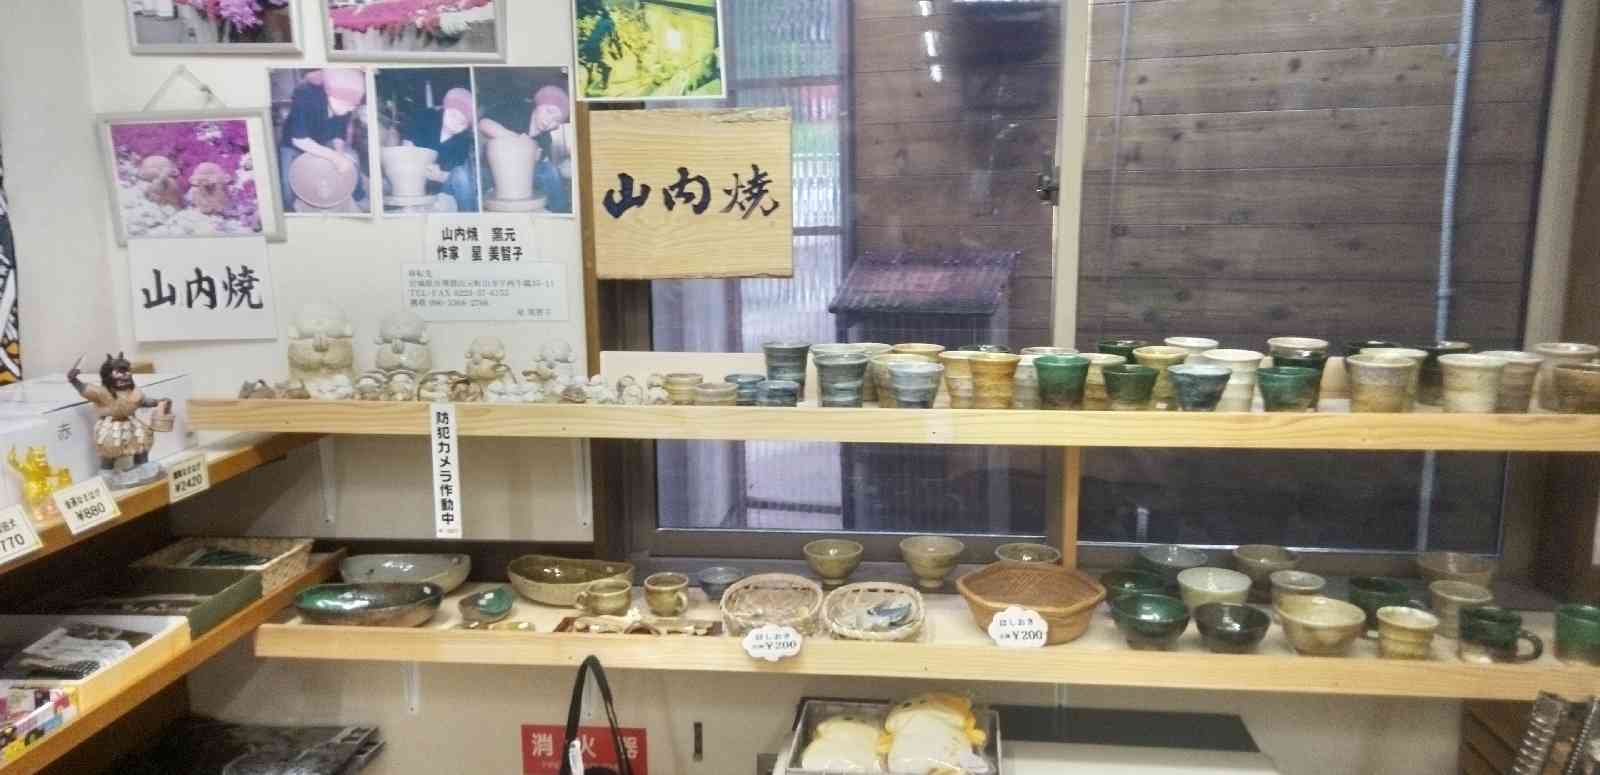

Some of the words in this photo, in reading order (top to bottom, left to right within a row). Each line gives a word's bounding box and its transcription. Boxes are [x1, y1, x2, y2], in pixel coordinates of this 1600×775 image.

[602, 164, 780, 220] 山内焼
[441, 227, 479, 241] 山内焼
[437, 245, 459, 261] 作家
[141, 265, 263, 309] 山内焼
[436, 411, 455, 525] 防犯カメラ作動中
[75, 501, 106, 521] ¥880
